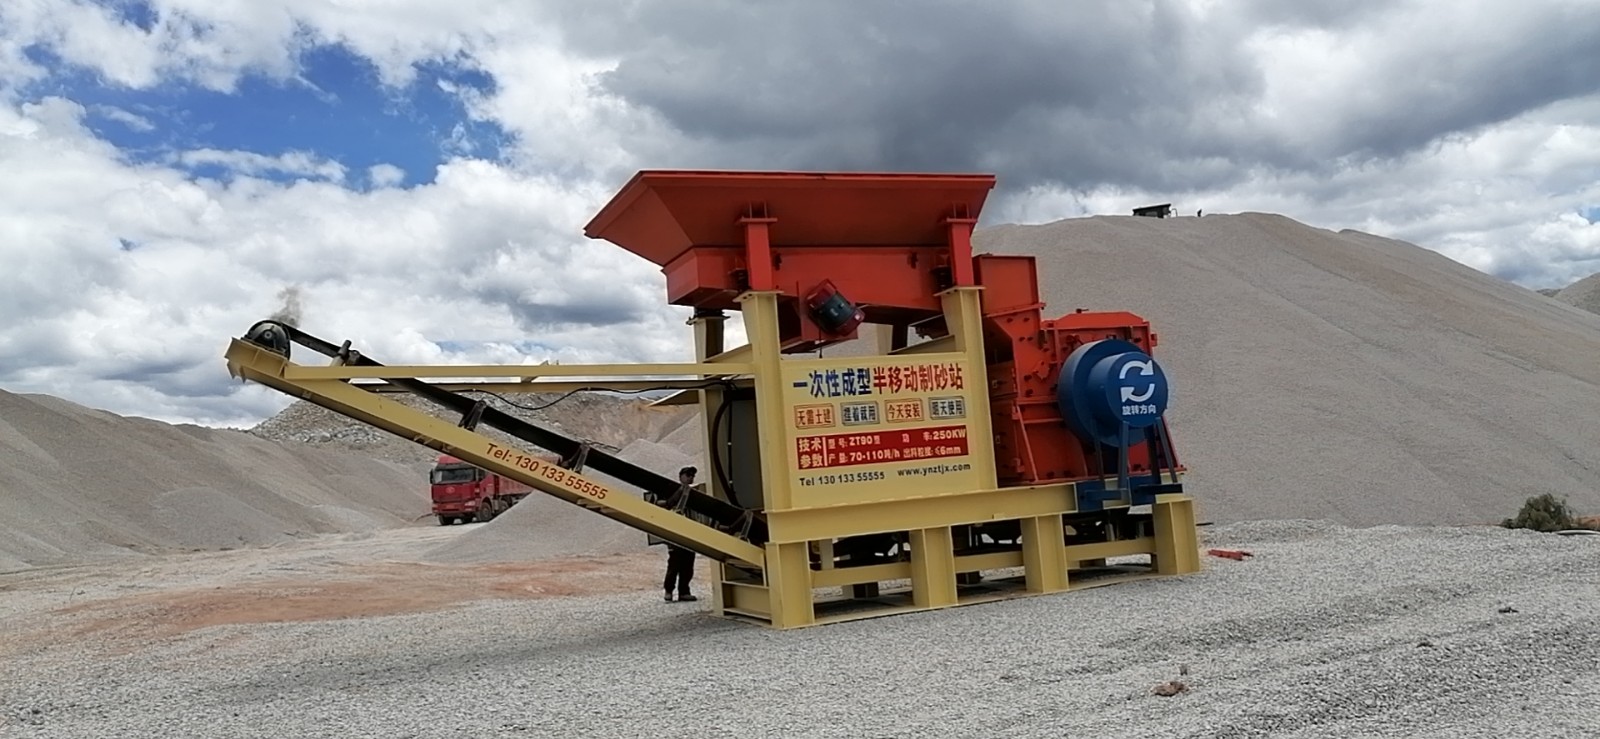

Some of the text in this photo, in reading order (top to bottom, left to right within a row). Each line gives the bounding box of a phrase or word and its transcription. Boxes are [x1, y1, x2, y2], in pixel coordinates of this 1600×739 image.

[888, 403, 921, 419] 今天安装
[1122, 404, 1157, 416] 旋转方向
[798, 437, 822, 453] 技术
[800, 452, 823, 469] 参数
[485, 442, 609, 500] Tel: 130 133 55555
[897, 463, 971, 477] www.ynztjx.com
[799, 471, 885, 486] Tel 130 133 55555
